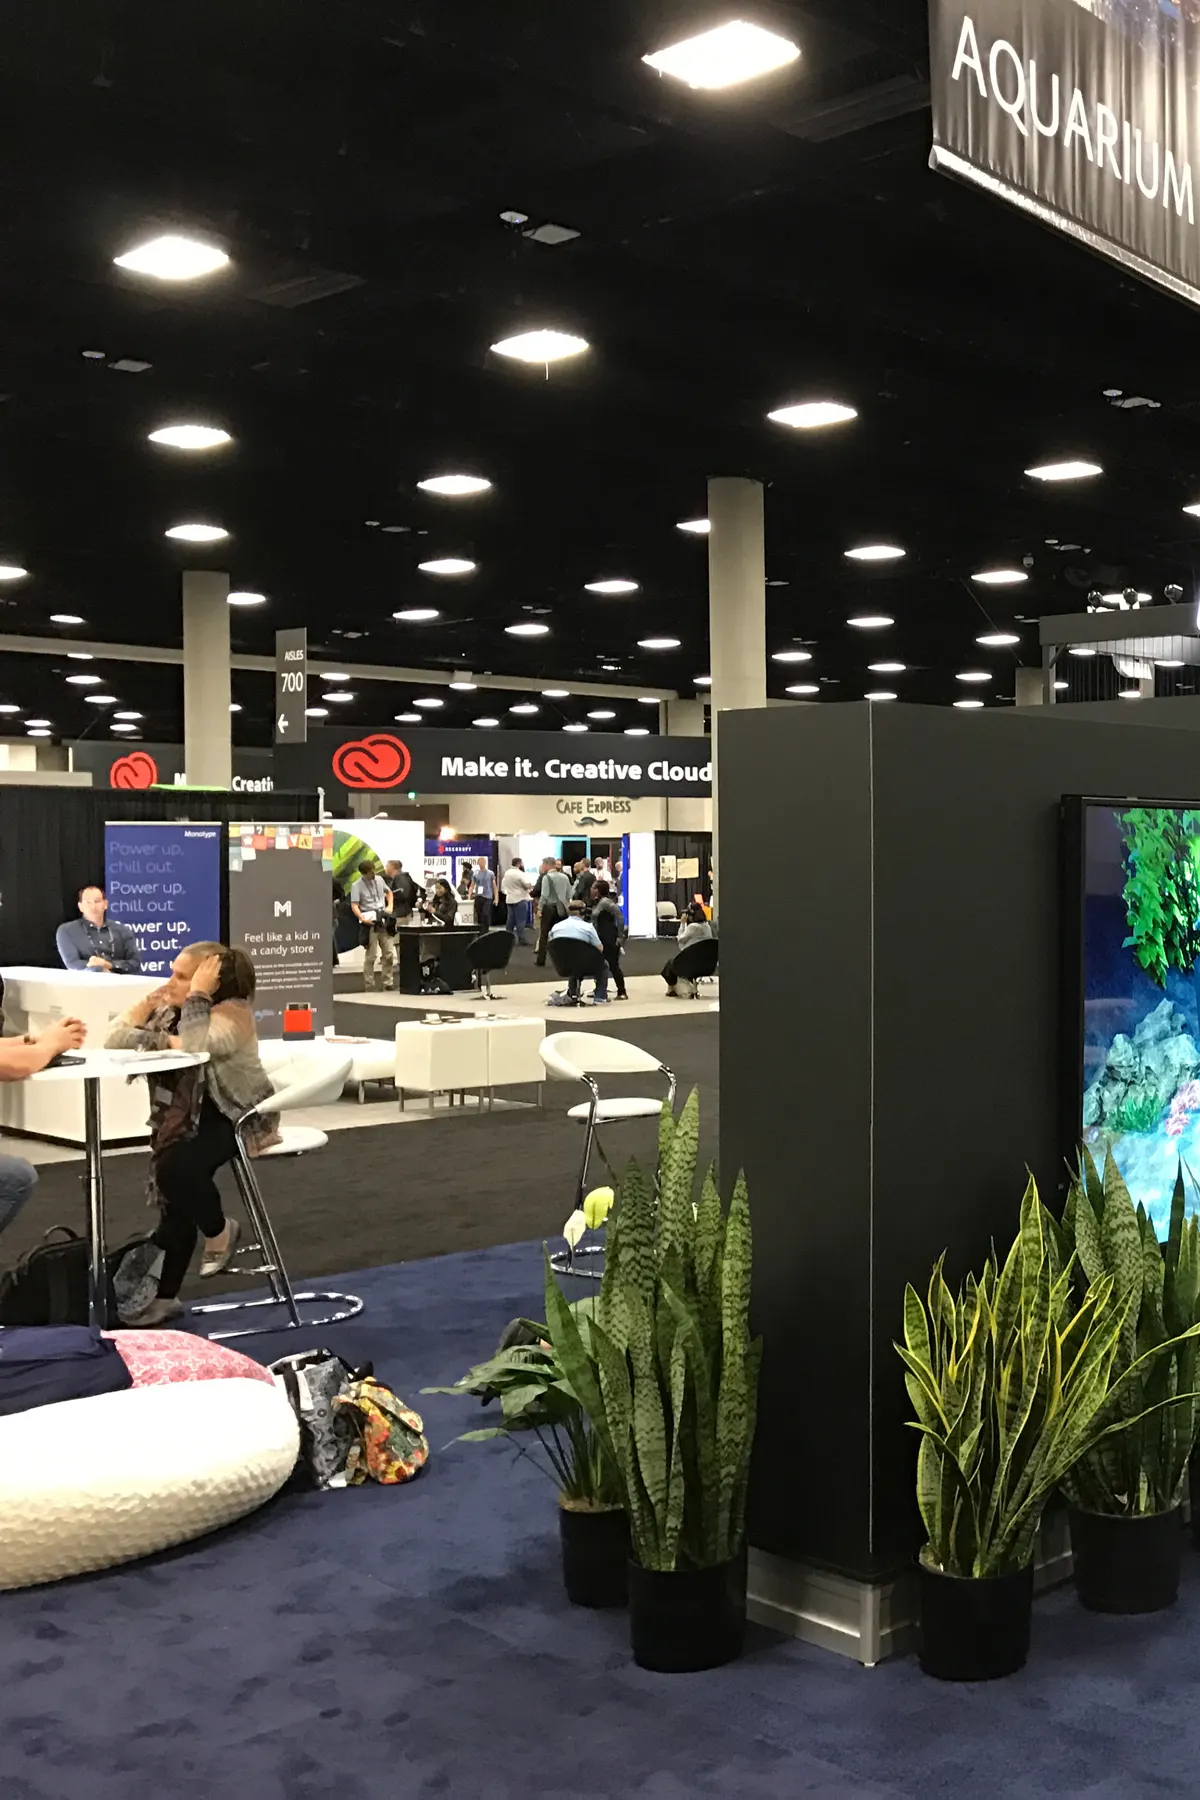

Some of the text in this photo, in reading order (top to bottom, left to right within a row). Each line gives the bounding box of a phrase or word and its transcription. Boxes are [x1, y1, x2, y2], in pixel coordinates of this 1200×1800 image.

[952, 15, 1194, 226] AQUARIUM
[284, 649, 304, 661] AISLES
[281, 671, 304, 692] 700
[441, 757, 712, 781] Make it. Creative Cloud
[110, 841, 158, 856] Power
[109, 860, 141, 874] chill
[110, 881, 159, 895] Power
[110, 900, 144, 913] chill
[167, 921, 190, 934] up,
[244, 931, 320, 943] Feel like a kid in
[150, 938, 181, 951] out.
[251, 945, 314, 957] a candy store
